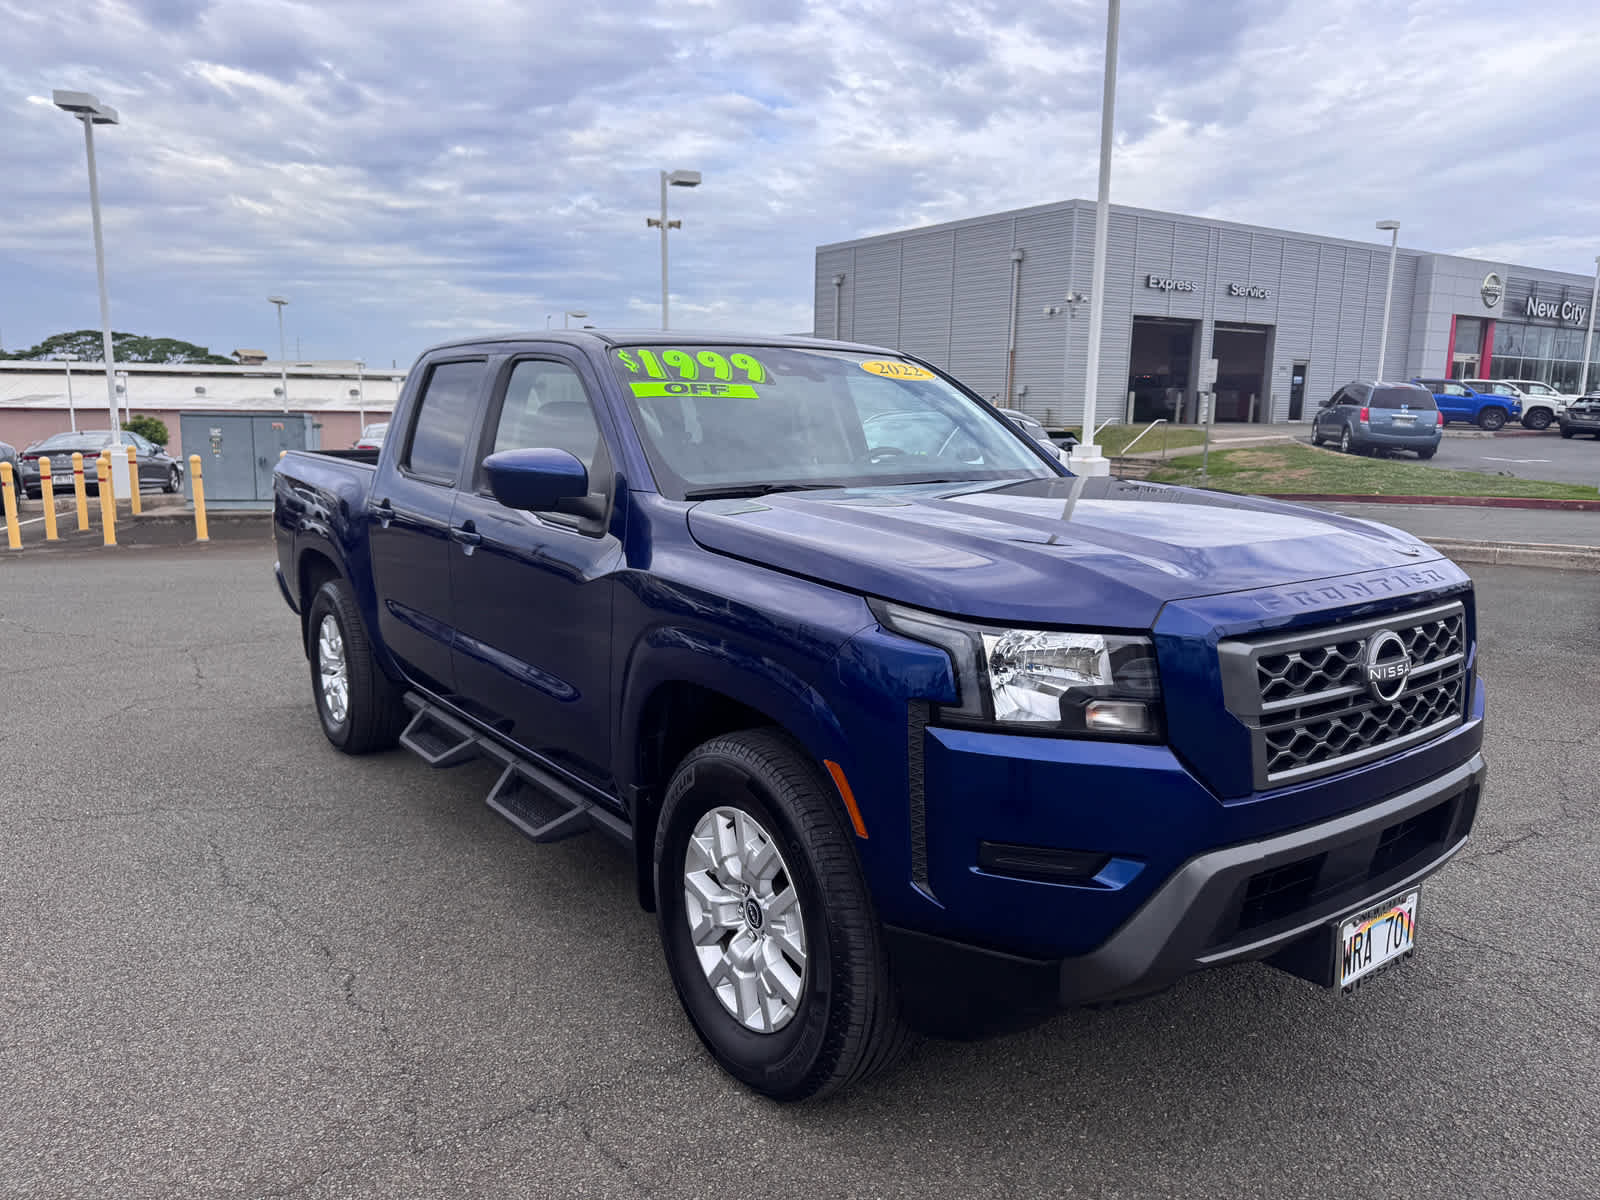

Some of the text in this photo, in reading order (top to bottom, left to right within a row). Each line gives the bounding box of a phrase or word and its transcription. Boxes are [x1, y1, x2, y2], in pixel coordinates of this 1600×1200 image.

[1145, 275, 1272, 298] Express Service
[1527, 296, 1586, 326] New City
[617, 349, 766, 384] $1999
[873, 363, 923, 376] 2022
[664, 383, 729, 395] OFF
[1254, 569, 1446, 613] FRONTIER
[1370, 663, 1410, 680] NISSA
[1343, 927, 1372, 979] WRA
[1385, 907, 1412, 955] 701
